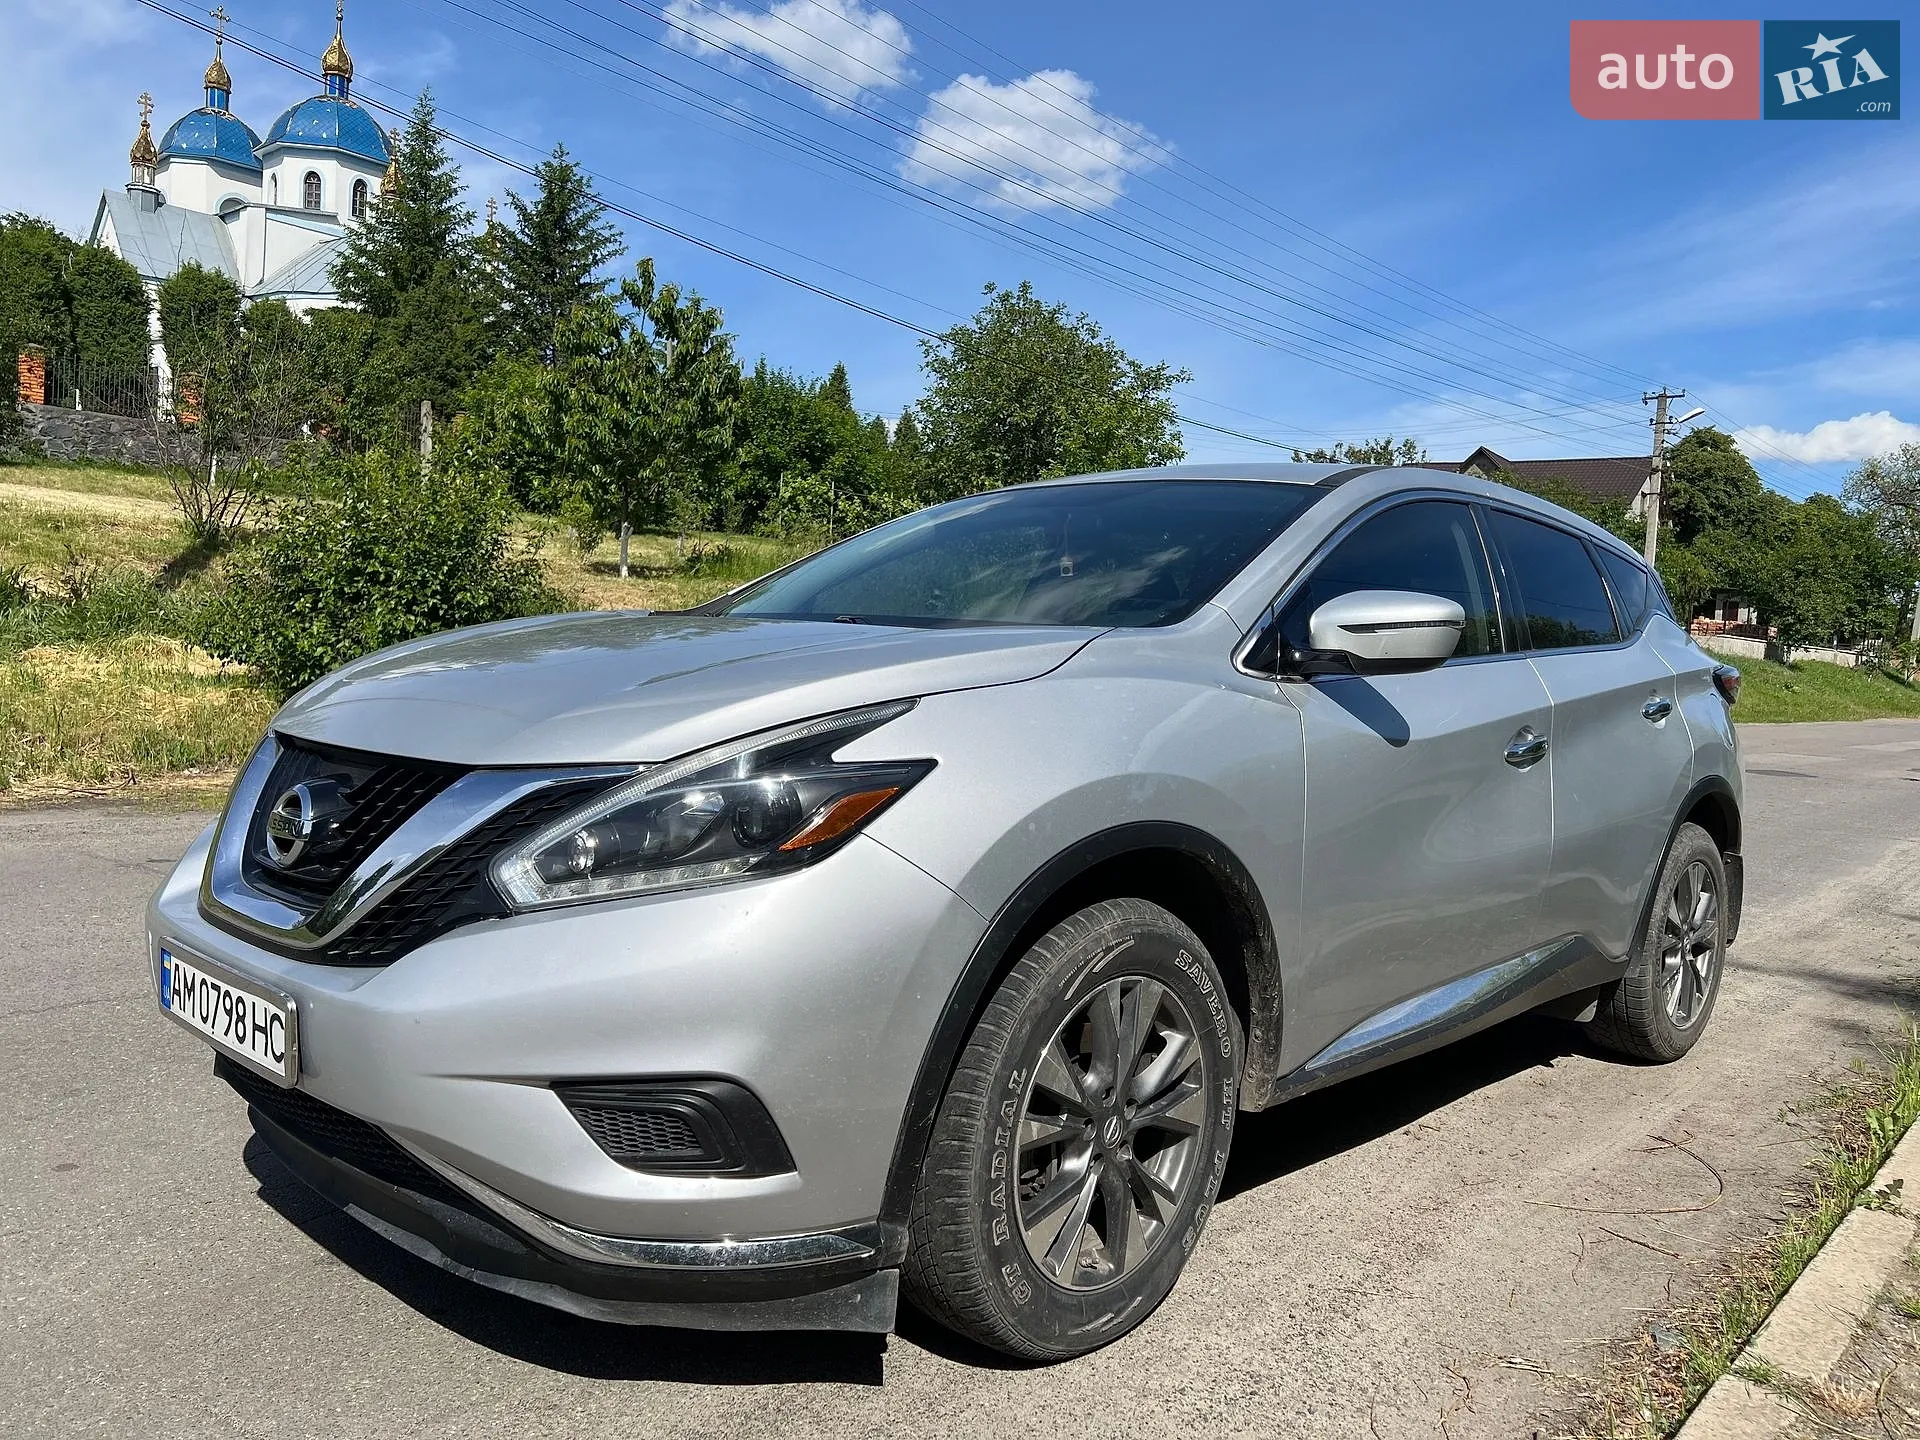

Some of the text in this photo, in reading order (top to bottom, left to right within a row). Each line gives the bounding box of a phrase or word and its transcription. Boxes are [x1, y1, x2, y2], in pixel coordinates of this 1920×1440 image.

[172, 963, 284, 1063] AM 0798 HC
[1175, 949, 1231, 1058] SAVERO
[991, 1068, 1032, 1305] GT RADIAL
